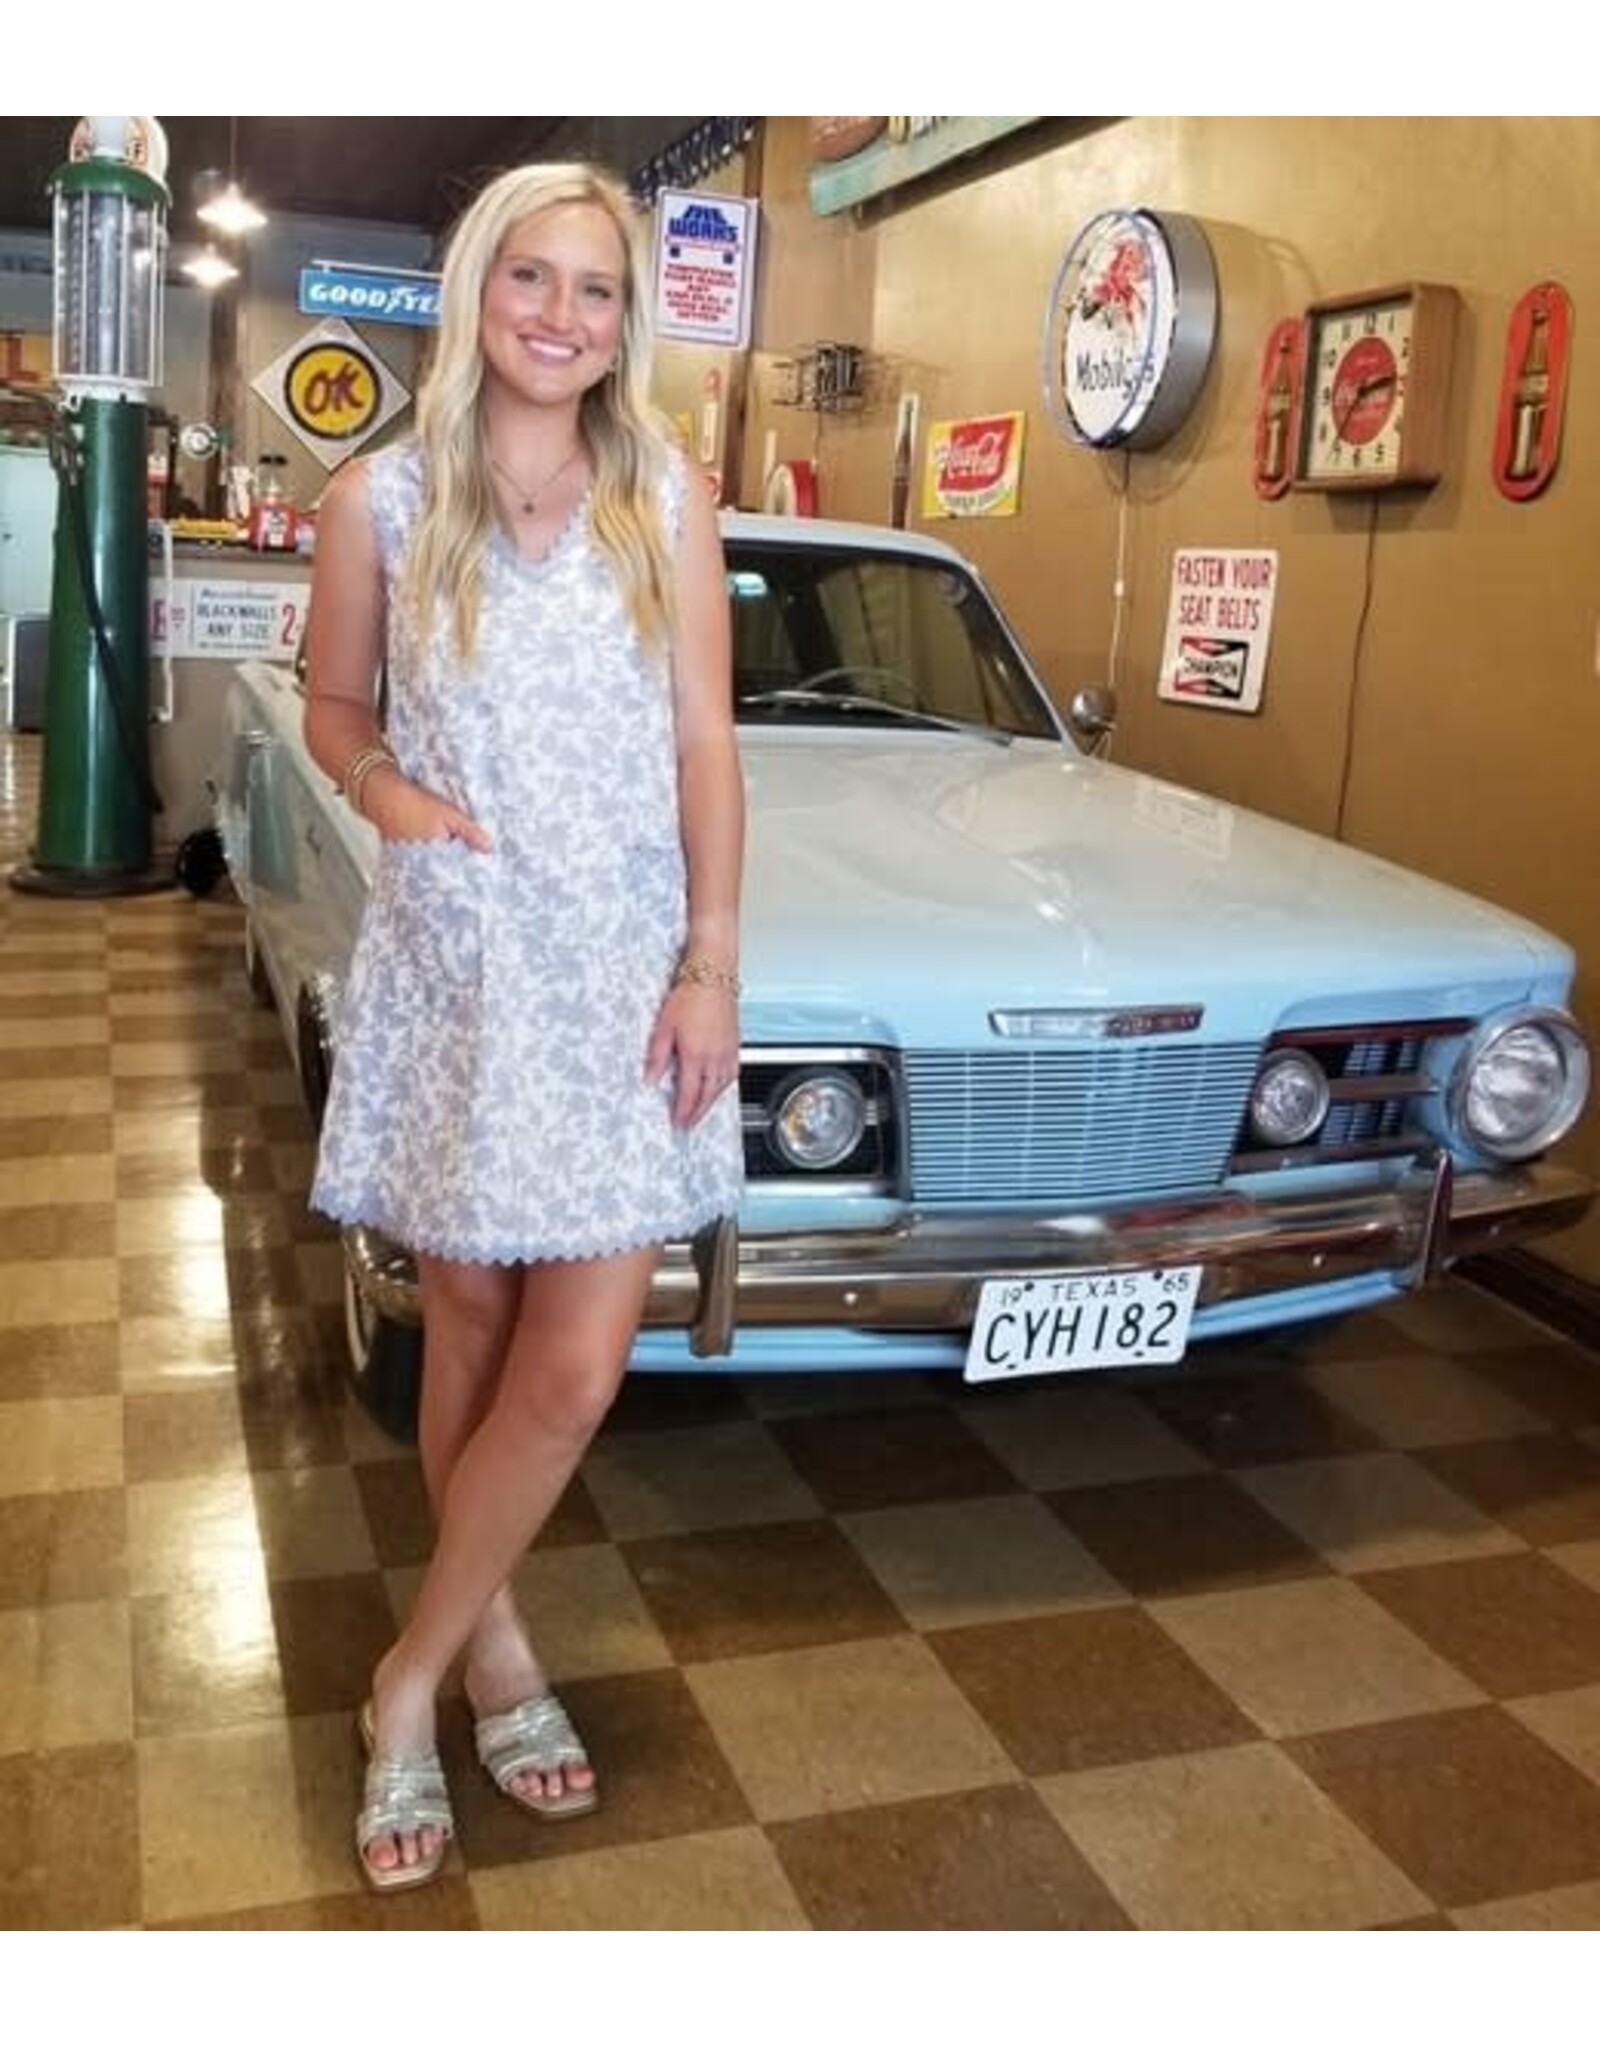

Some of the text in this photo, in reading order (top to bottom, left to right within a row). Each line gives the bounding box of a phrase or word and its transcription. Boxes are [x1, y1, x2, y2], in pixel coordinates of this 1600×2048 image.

[669, 217, 739, 243] WORKS
[304, 361, 364, 415] OK
[1178, 557, 1272, 589] FASTEN YOUR
[282, 603, 297, 646] 2
[1180, 594, 1261, 631] SEAT BELTS
[207, 622, 269, 640] ANY SIZE
[1183, 656, 1238, 679] CHAMPION
[1050, 1278, 1137, 1302] TEXAS
[1162, 1272, 1191, 1293] 65
